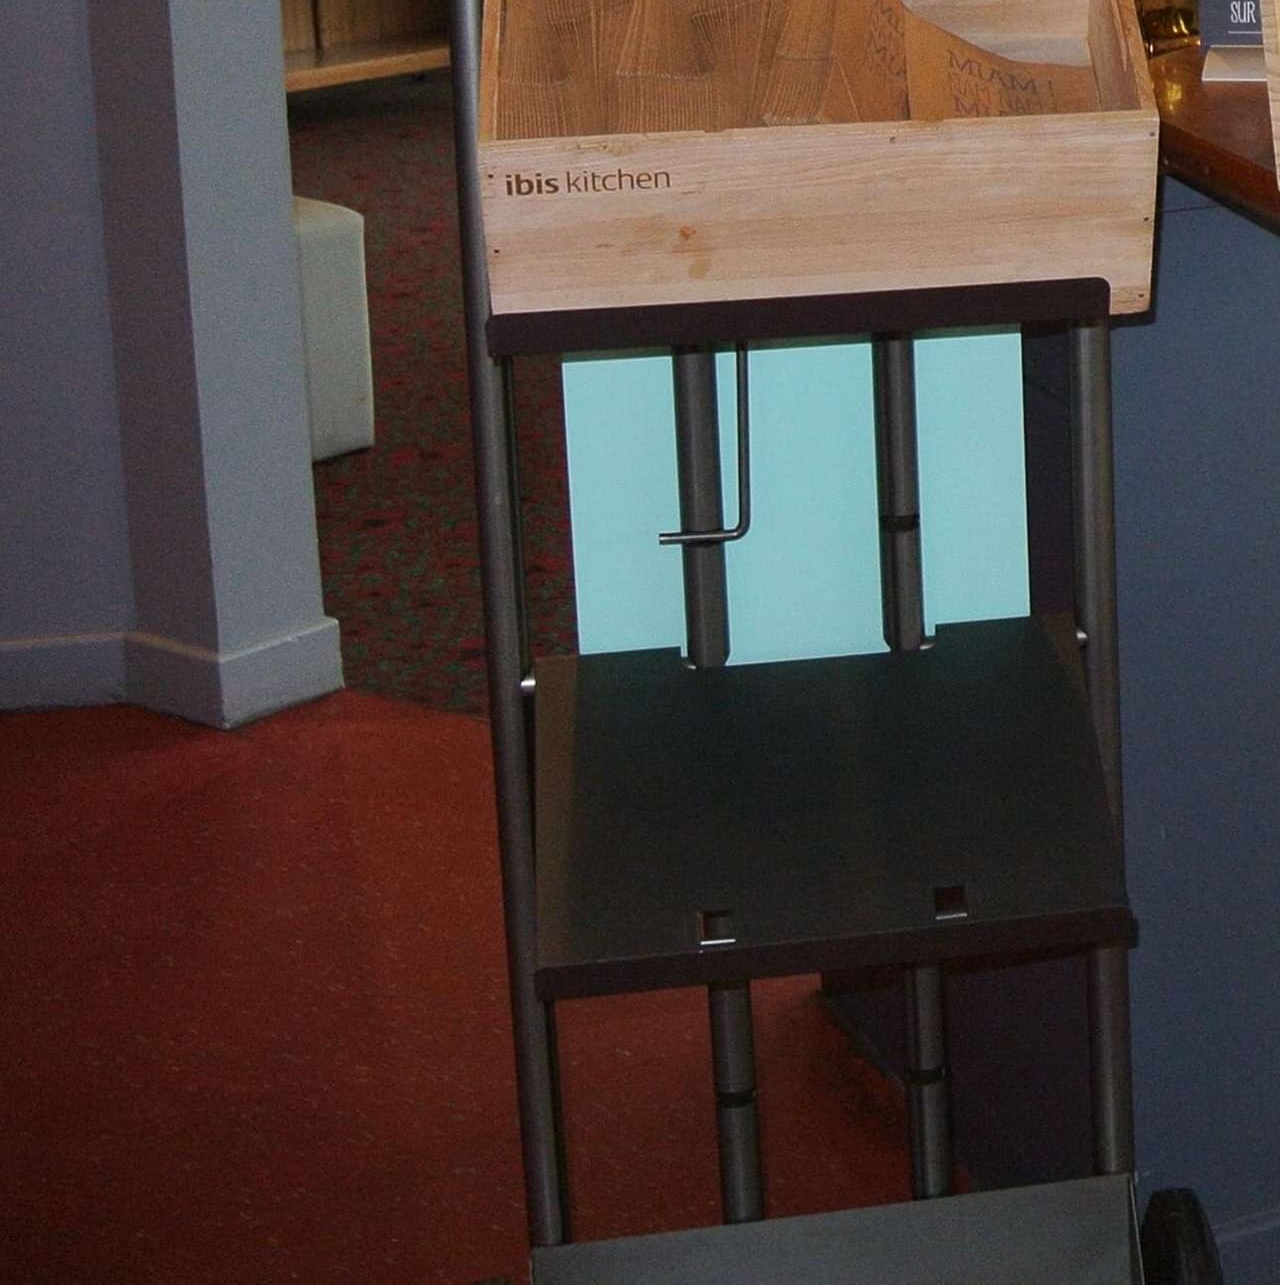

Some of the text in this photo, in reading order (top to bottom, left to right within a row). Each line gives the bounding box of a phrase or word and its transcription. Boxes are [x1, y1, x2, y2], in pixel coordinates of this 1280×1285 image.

[1230, 1, 1256, 23] SUR
[505, 169, 671, 196] ibis kitchen
